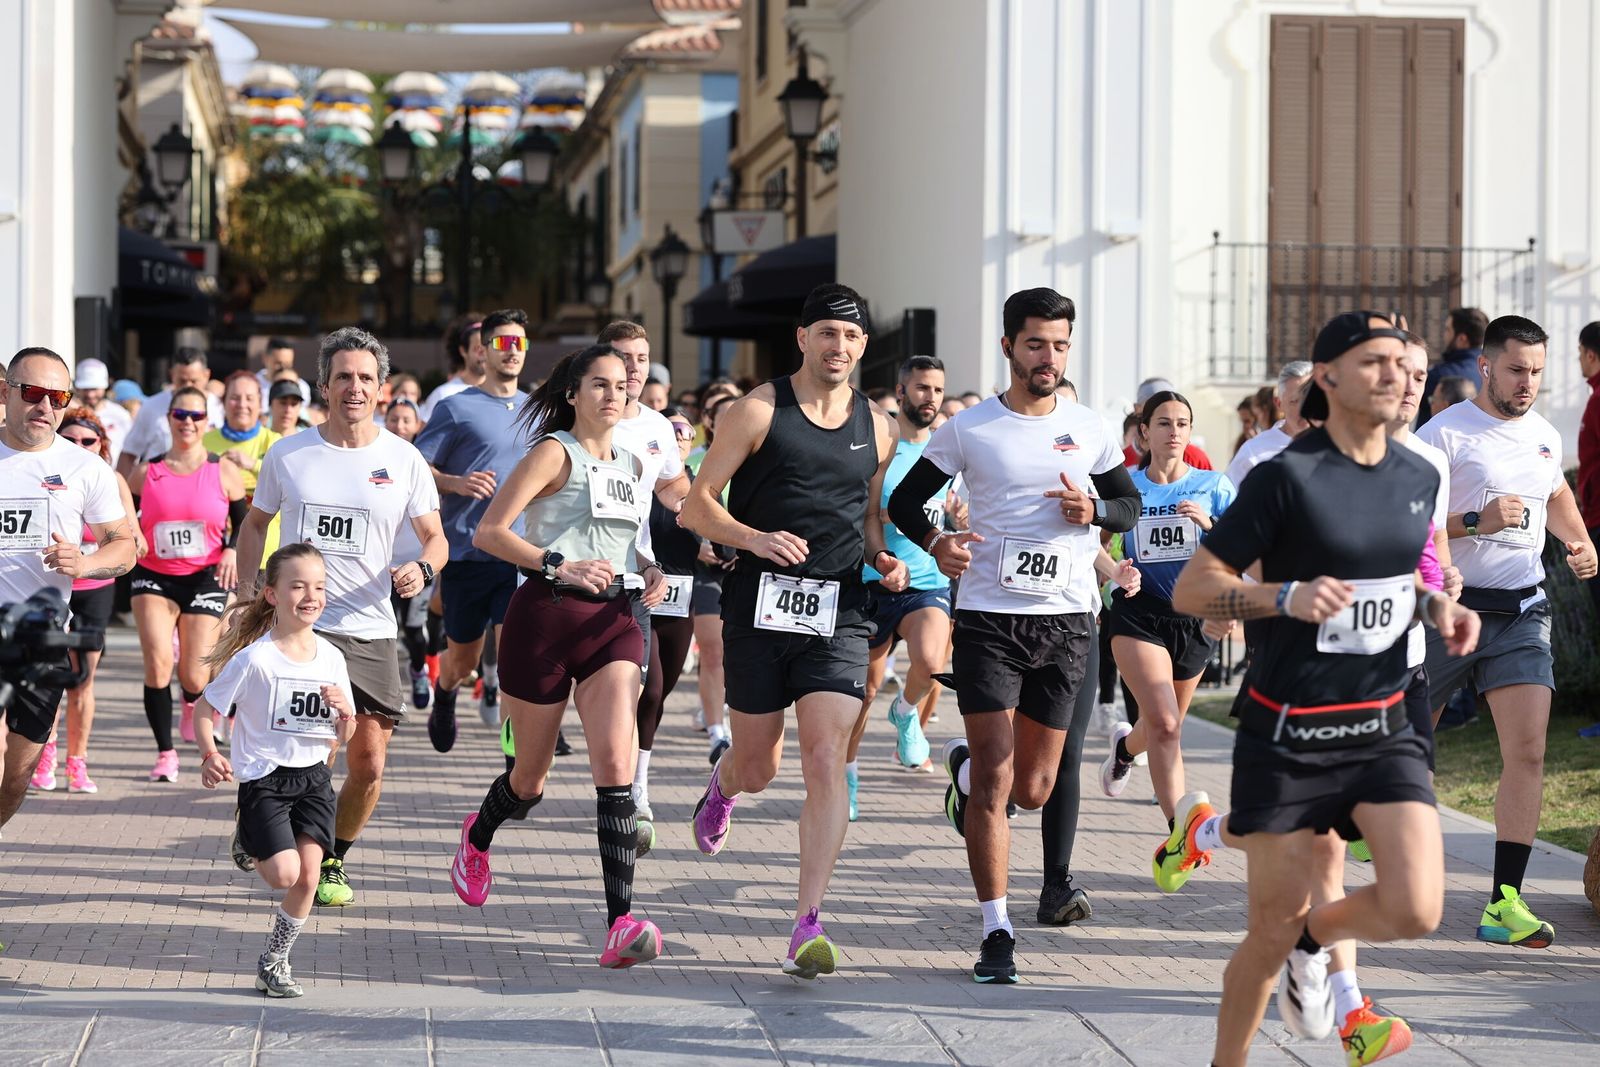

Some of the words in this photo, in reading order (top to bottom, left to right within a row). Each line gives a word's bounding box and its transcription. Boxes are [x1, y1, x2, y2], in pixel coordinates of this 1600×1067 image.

[606, 478, 635, 506] 408
[0, 509, 33, 534] 57
[317, 514, 353, 540] 501
[169, 529, 192, 546] 119
[1149, 526, 1185, 548] 494
[1016, 551, 1059, 579] 284
[190, 599, 225, 613] PRO
[775, 589, 820, 617] 488
[1350, 598, 1393, 632] 108
[1286, 718, 1380, 741] WONG
